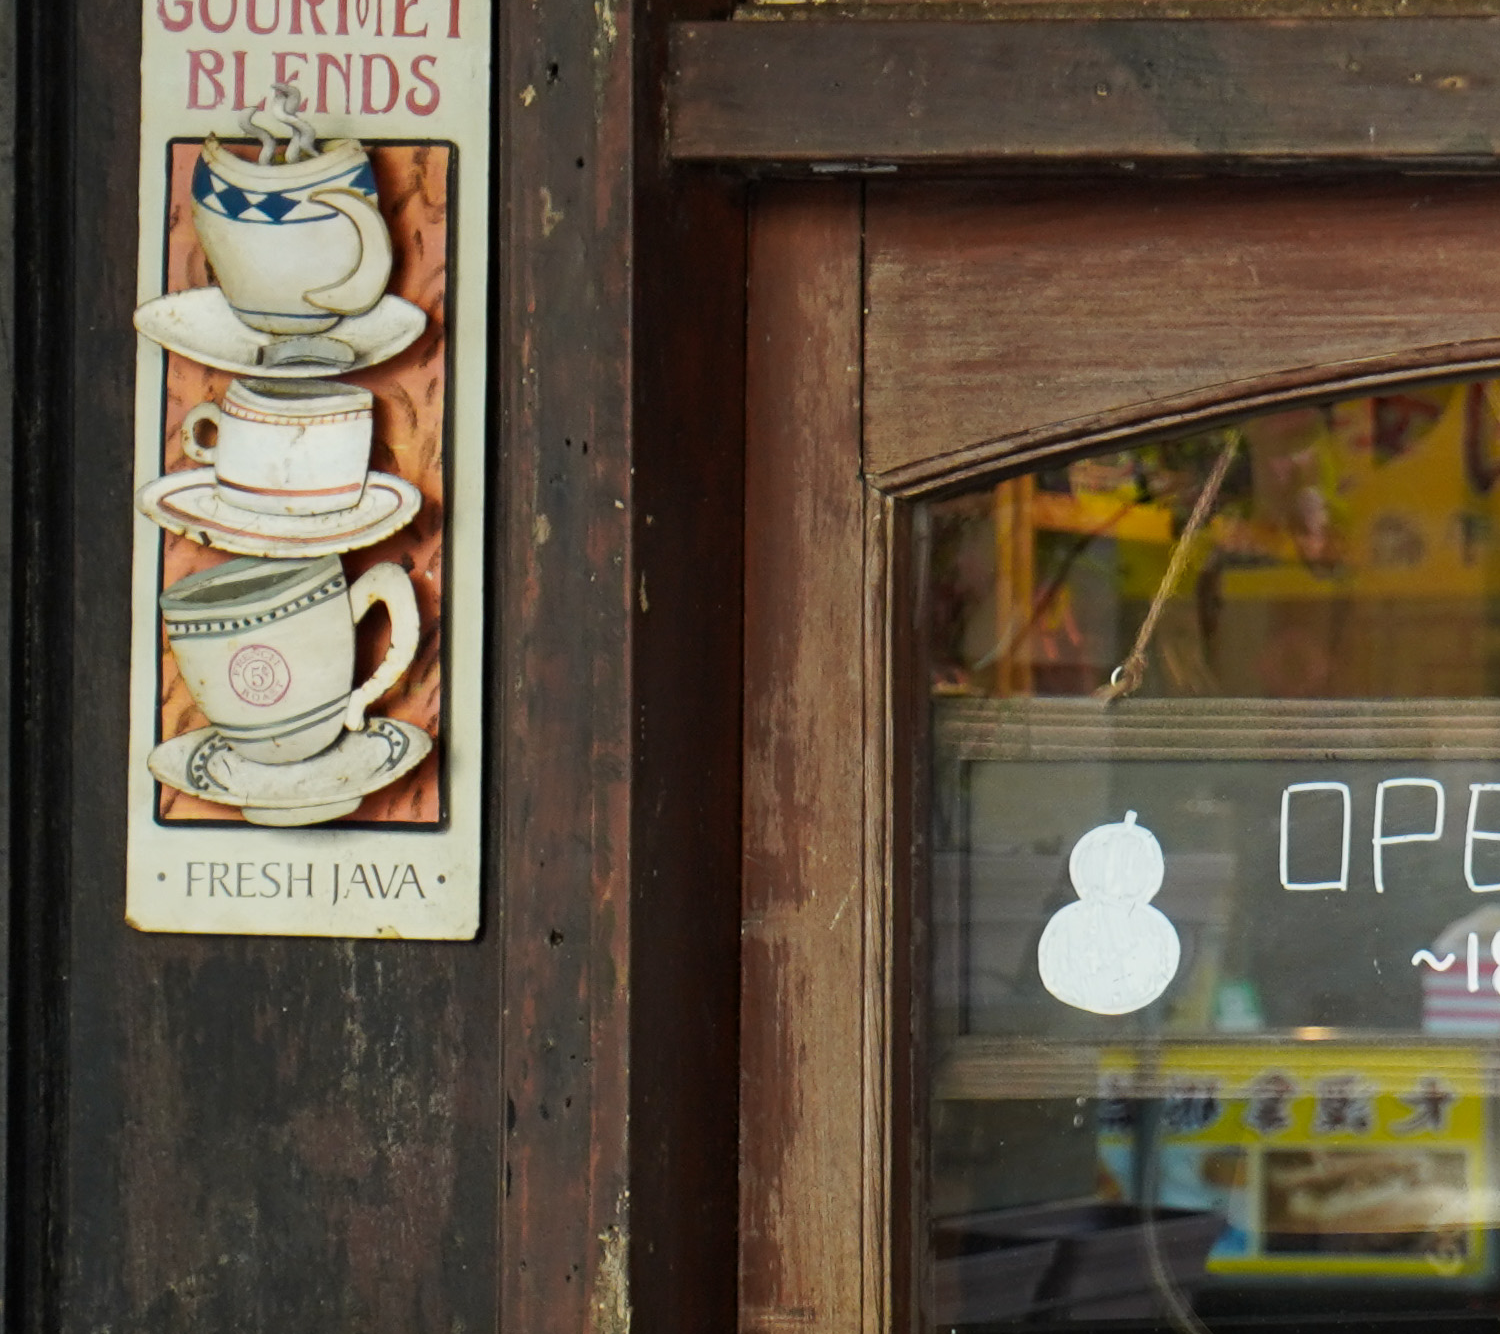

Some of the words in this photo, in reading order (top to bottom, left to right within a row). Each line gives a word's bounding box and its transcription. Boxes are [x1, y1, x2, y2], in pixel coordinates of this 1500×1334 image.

[186, 49, 441, 116] BLENDS
[185, 861, 314, 899] FRESH
[331, 863, 427, 907] JAVA
